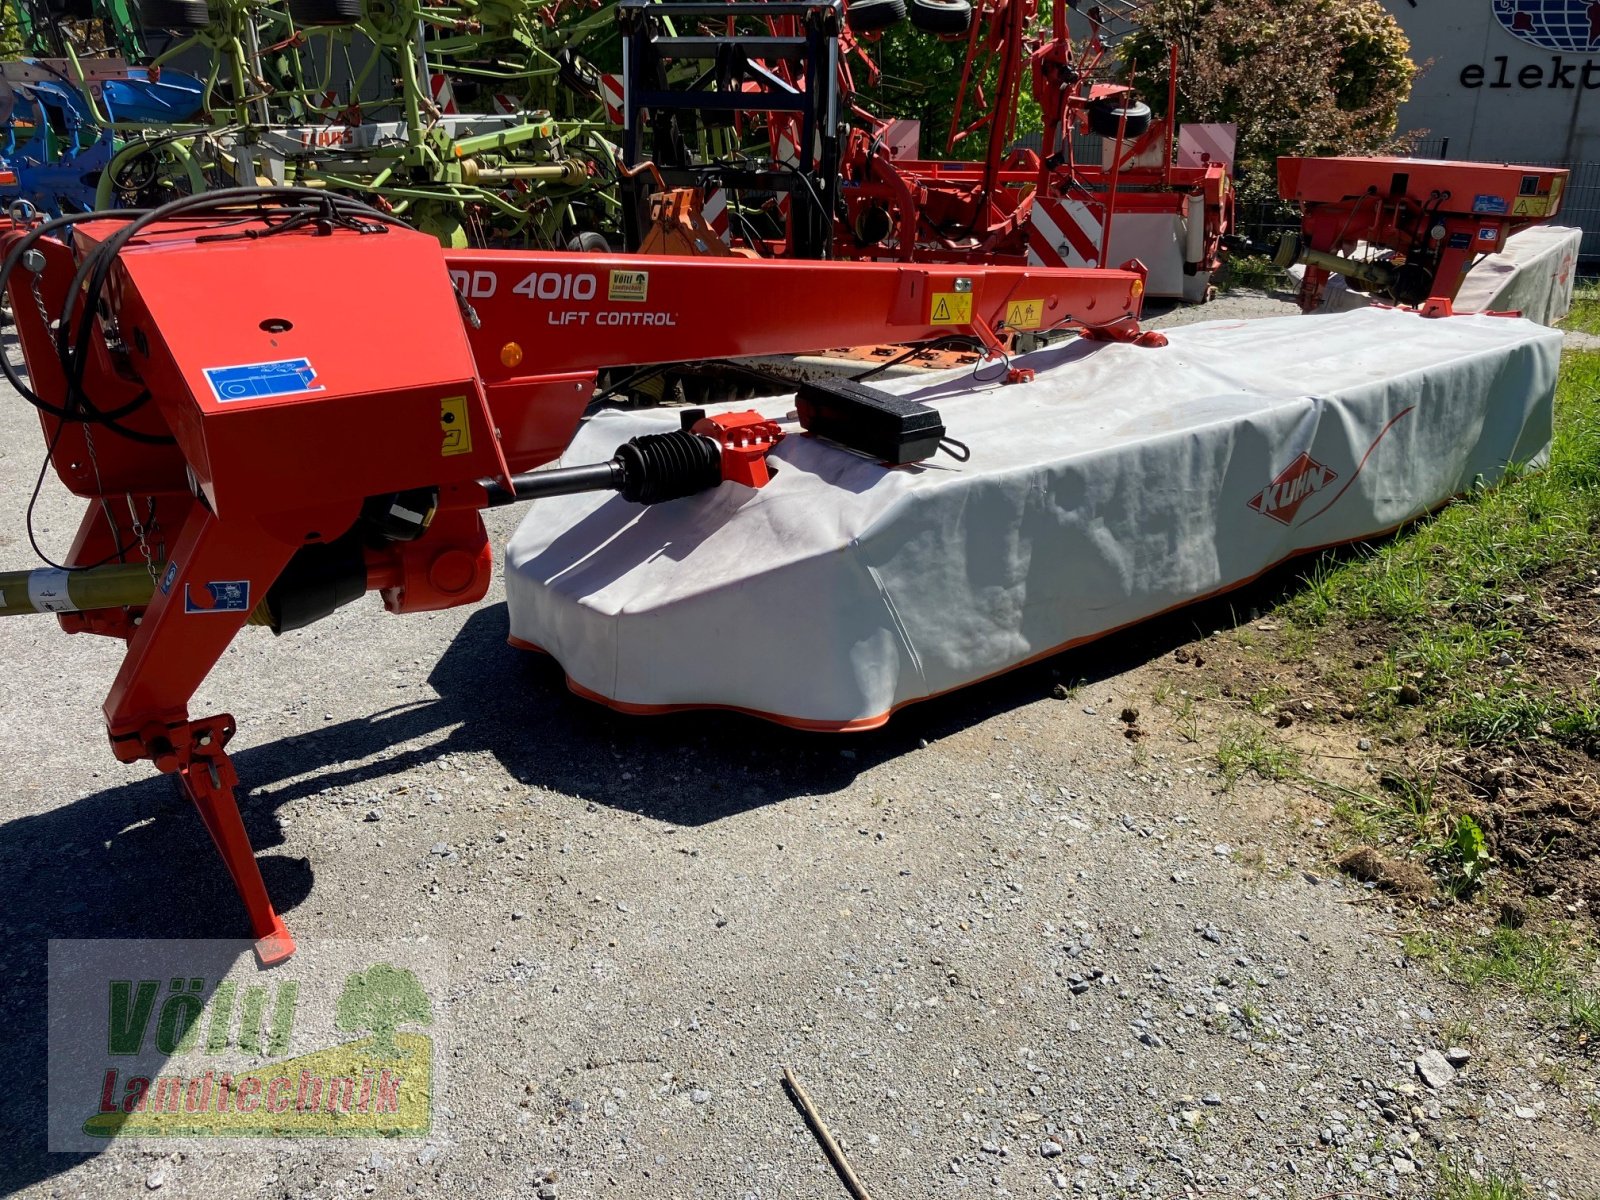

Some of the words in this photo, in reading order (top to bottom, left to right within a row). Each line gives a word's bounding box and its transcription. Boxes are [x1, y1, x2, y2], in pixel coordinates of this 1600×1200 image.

[512, 271, 597, 301] 4010
[548, 311, 590, 326] LIFT
[596, 311, 676, 327] CONTROL
[1258, 464, 1328, 515] KUHN
